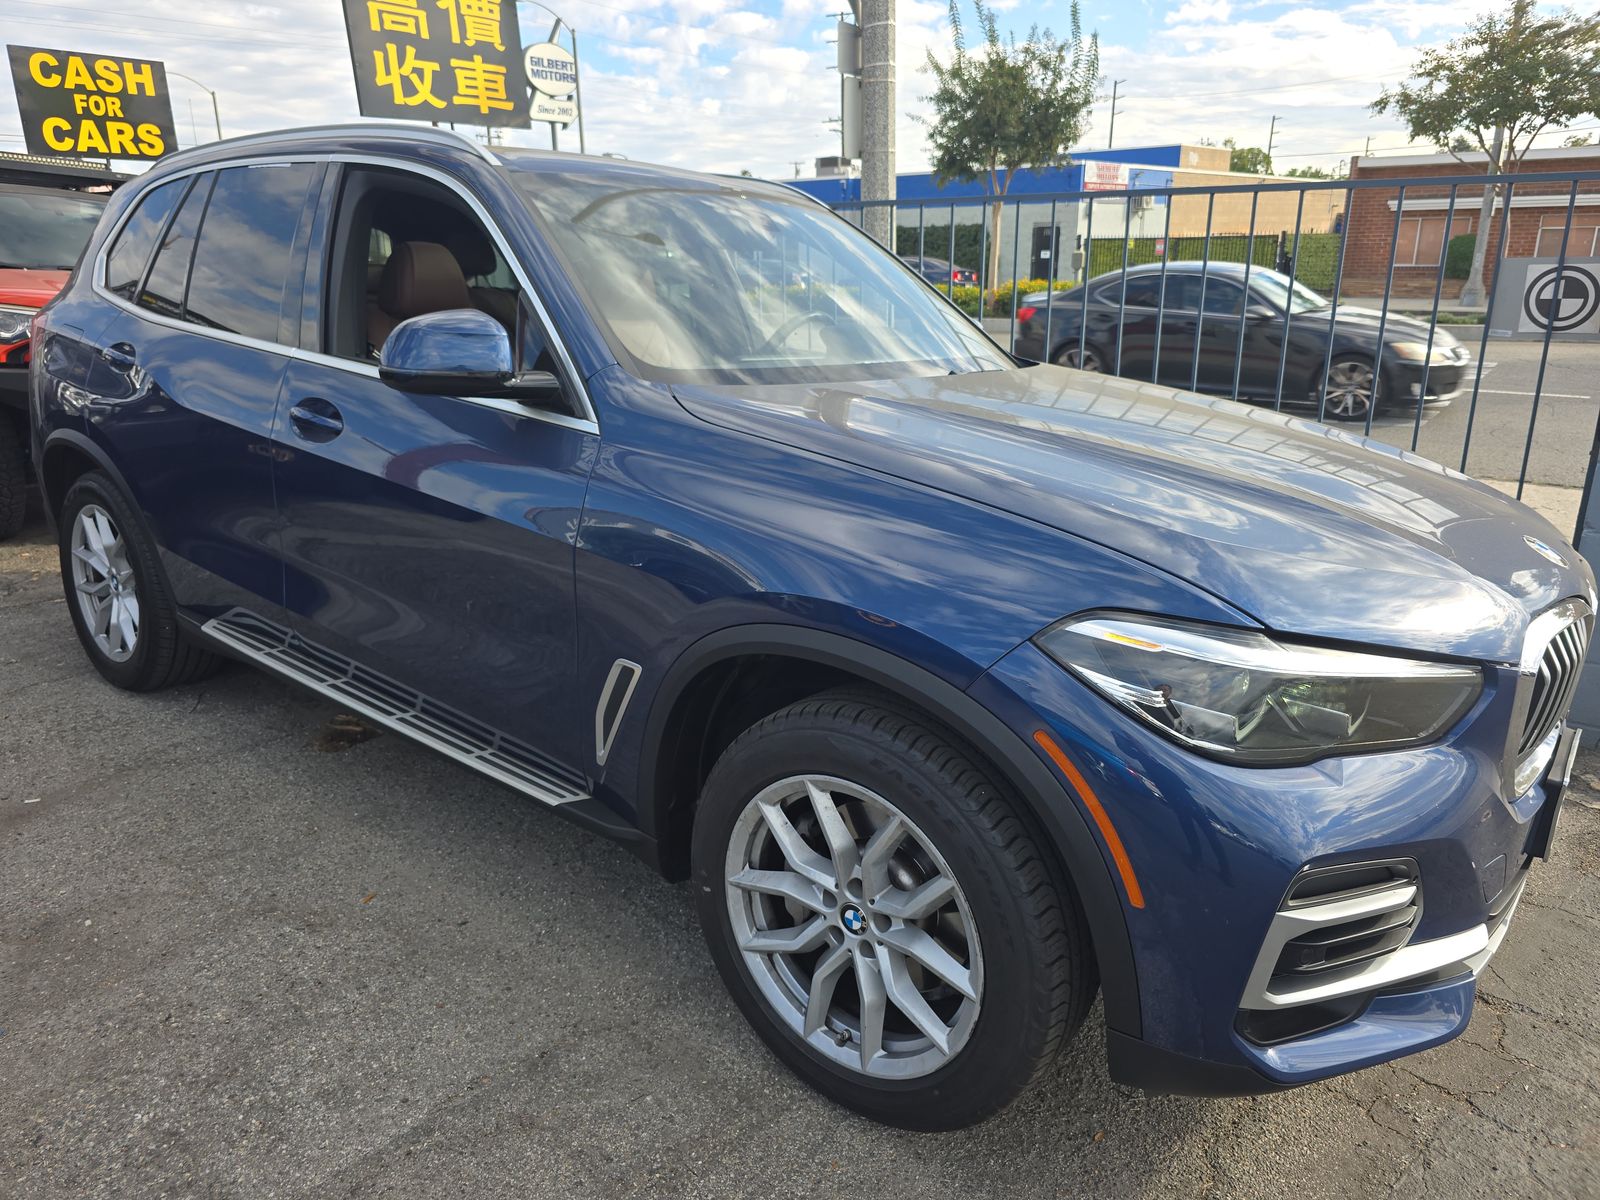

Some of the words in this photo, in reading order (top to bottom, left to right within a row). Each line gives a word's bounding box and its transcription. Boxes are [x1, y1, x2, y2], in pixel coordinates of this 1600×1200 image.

[28, 52, 156, 97] CASH
[530, 56, 575, 72] GILBERT
[531, 68, 577, 84] MOTORS
[373, 42, 514, 114] 收車
[73, 93, 124, 118] FOR
[537, 104, 556, 115] Since
[557, 106, 574, 117] 2002
[42, 116, 165, 157] CARS
